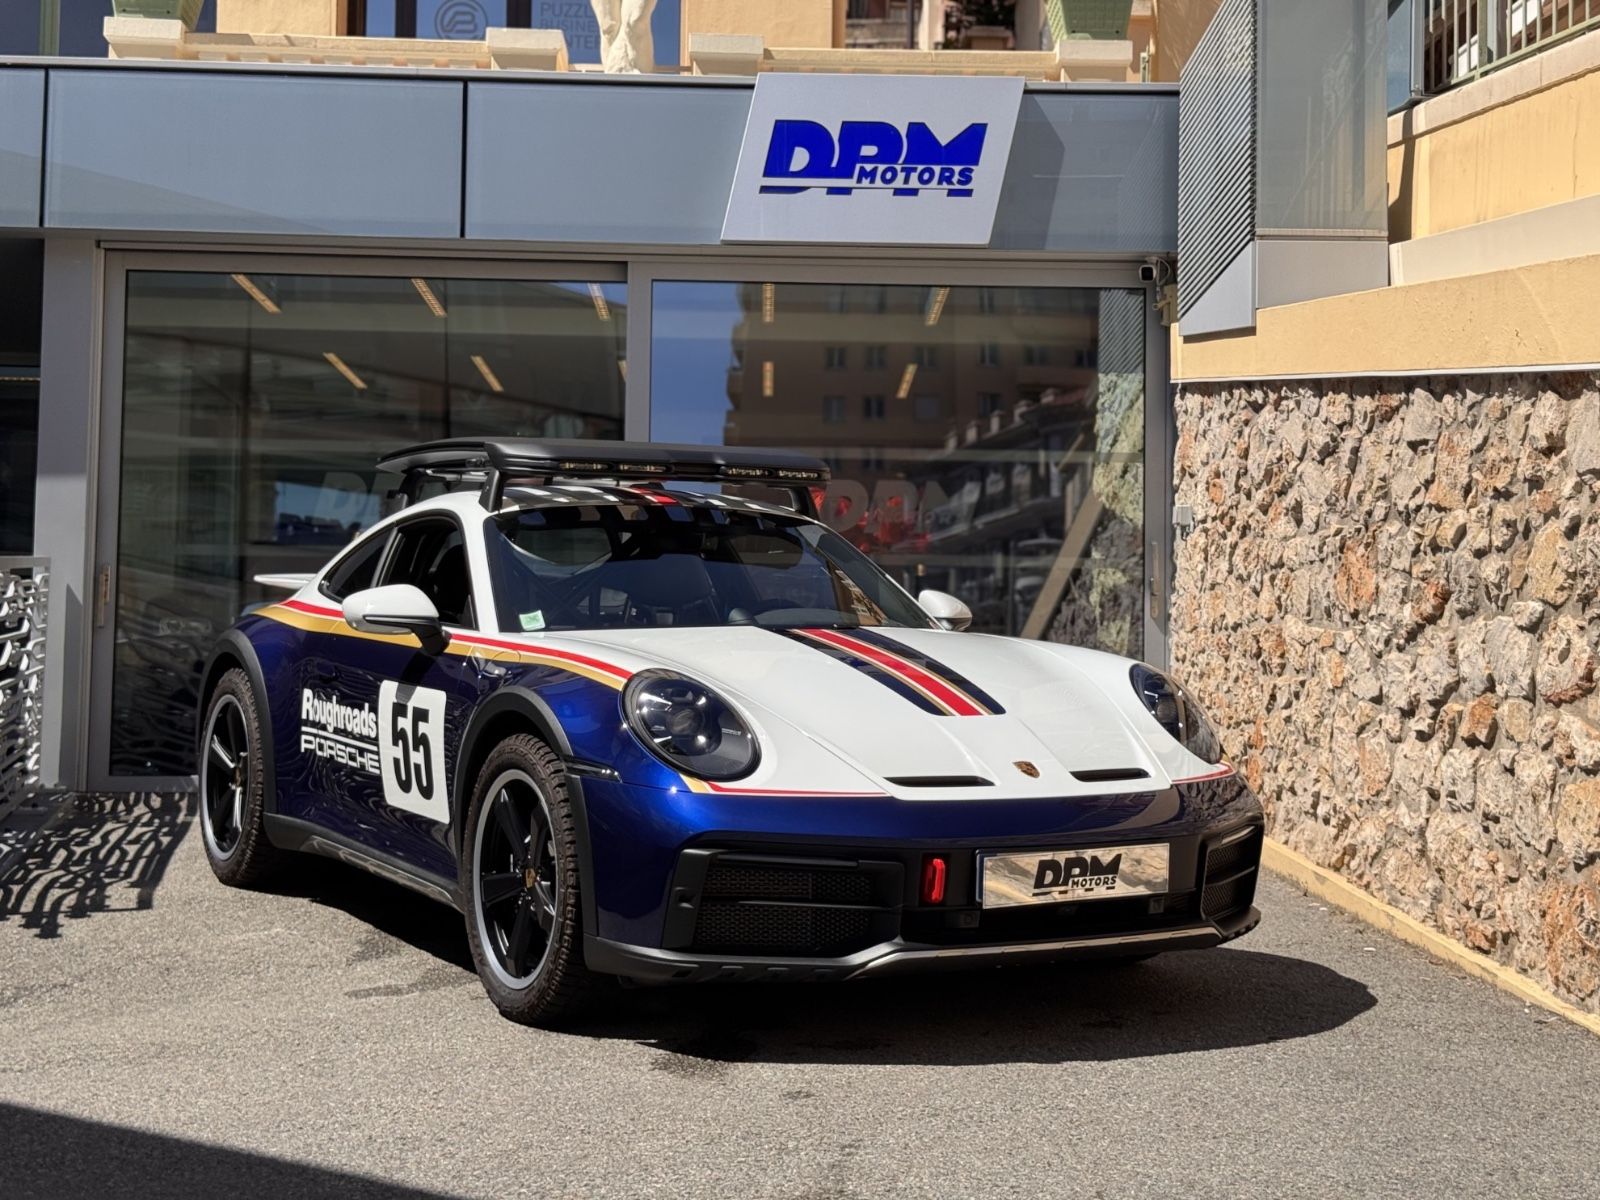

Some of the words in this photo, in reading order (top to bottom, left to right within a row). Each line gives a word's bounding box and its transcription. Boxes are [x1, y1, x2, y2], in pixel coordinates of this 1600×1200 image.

[540, 2, 594, 18] PUZZL
[540, 18, 596, 33] BUSINE
[759, 119, 988, 197] DPM
[856, 166, 974, 186] MOTORS
[301, 688, 377, 738] Roughroads
[301, 735, 380, 774] PORSCHE
[391, 702, 434, 801] 55
[1032, 853, 1122, 897] DPM
[1071, 875, 1117, 889] MOTORS
